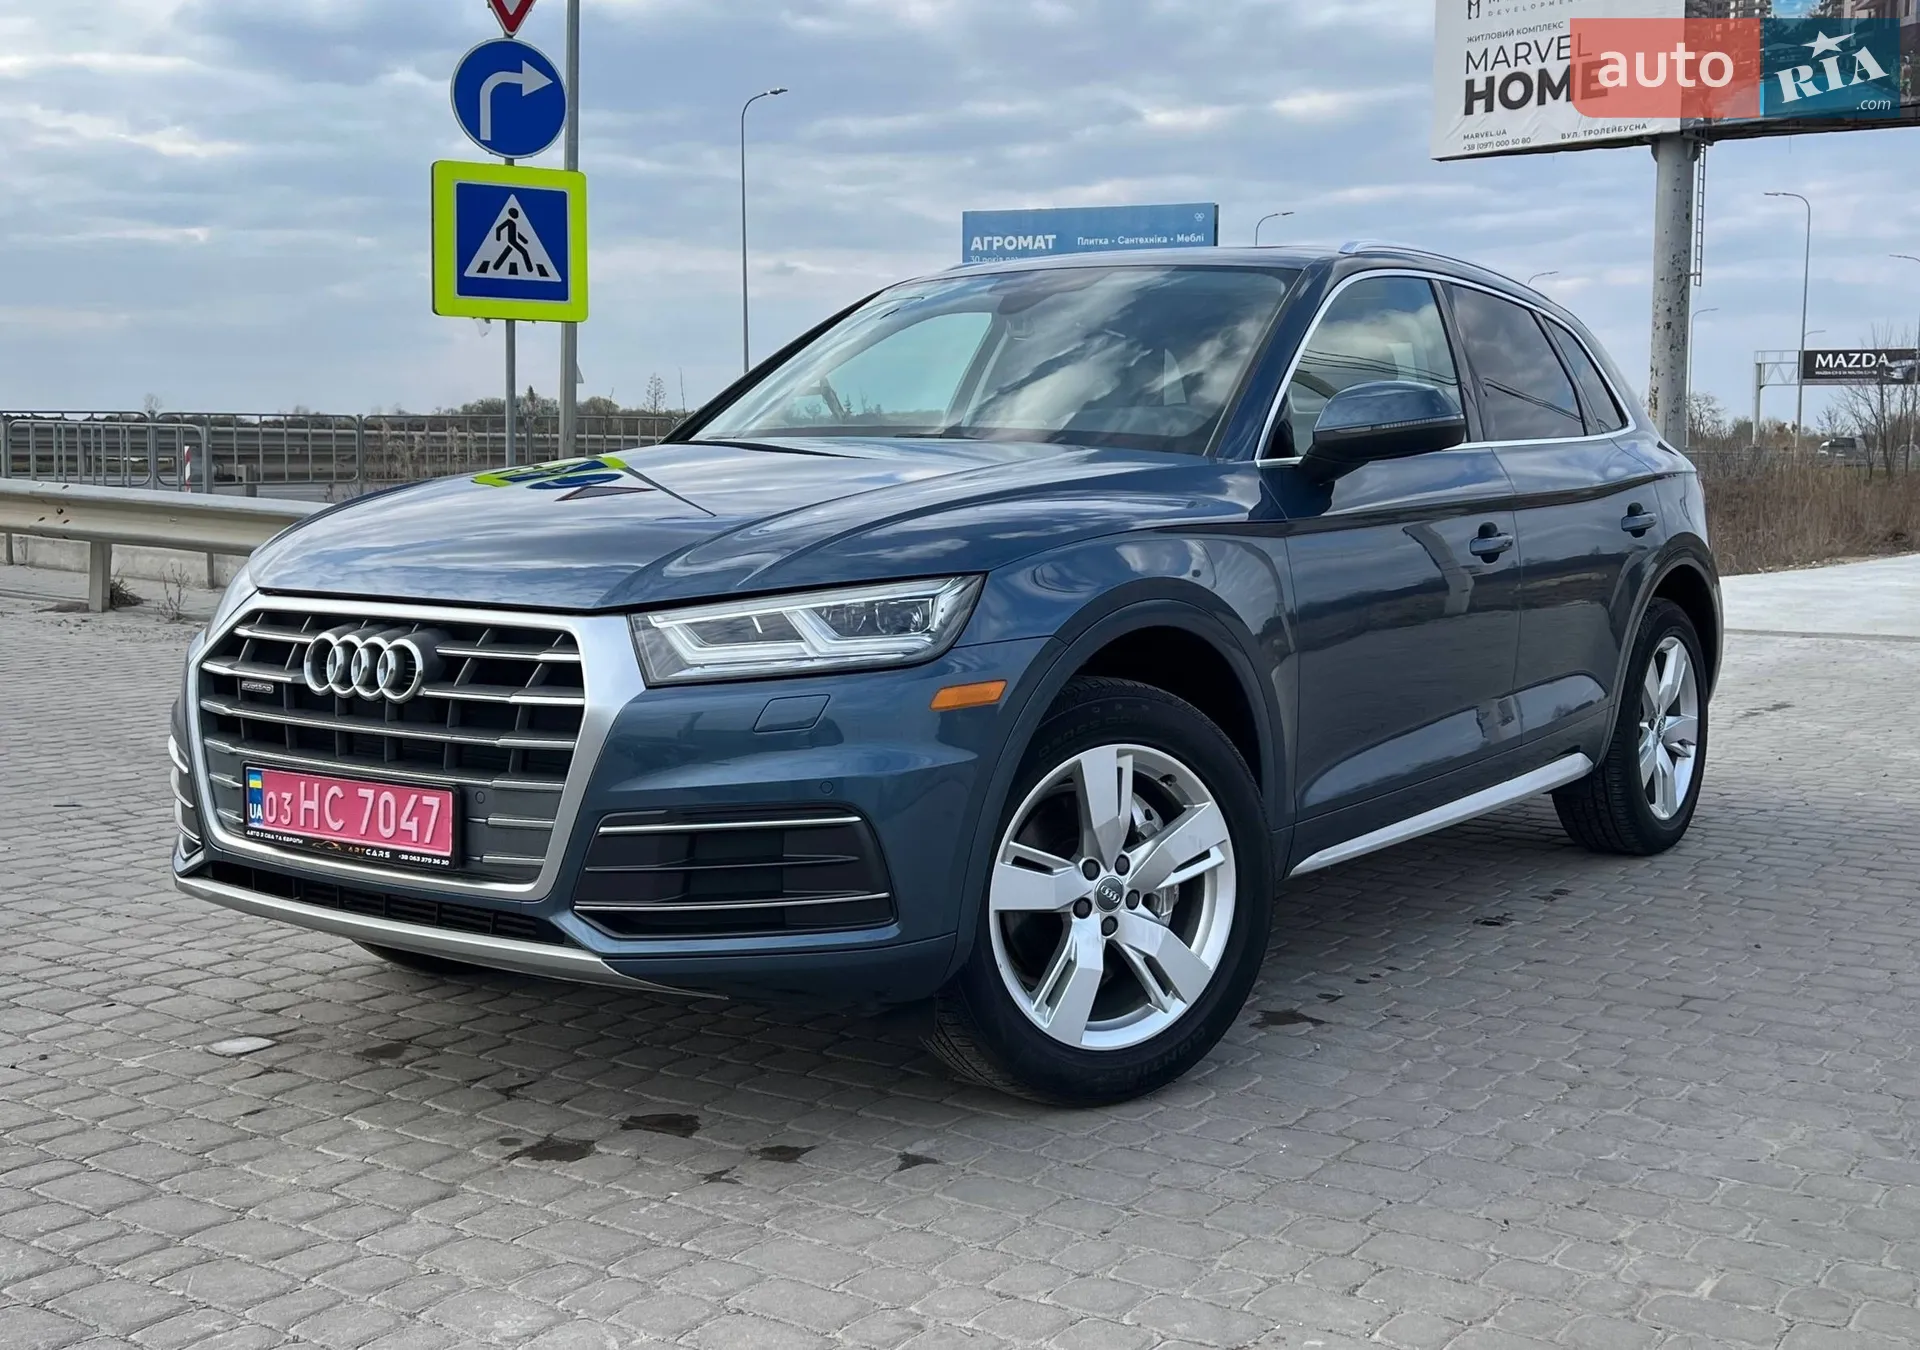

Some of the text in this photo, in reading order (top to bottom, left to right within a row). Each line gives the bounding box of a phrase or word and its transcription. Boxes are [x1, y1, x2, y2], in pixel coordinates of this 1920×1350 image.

[1467, 21, 1564, 43] ЖИТЛОВИЙ КОМПЛЕКС
[1466, 33, 1592, 74] MARVEL
[1464, 59, 1609, 116] HOME
[1463, 129, 1507, 140] MARVEL.UA
[1583, 123, 1647, 136] ТРОЛЕЙБУСНА
[1496, 139, 1509, 147] 000
[970, 235, 1056, 251] АГРОМАТ
[1077, 233, 1205, 246] Плитка Сантехніка Меблі
[1815, 352, 1889, 369] MAZDA
[249, 803, 263, 820] UA
[265, 791, 293, 825] 03
[357, 787, 440, 844] 7047
